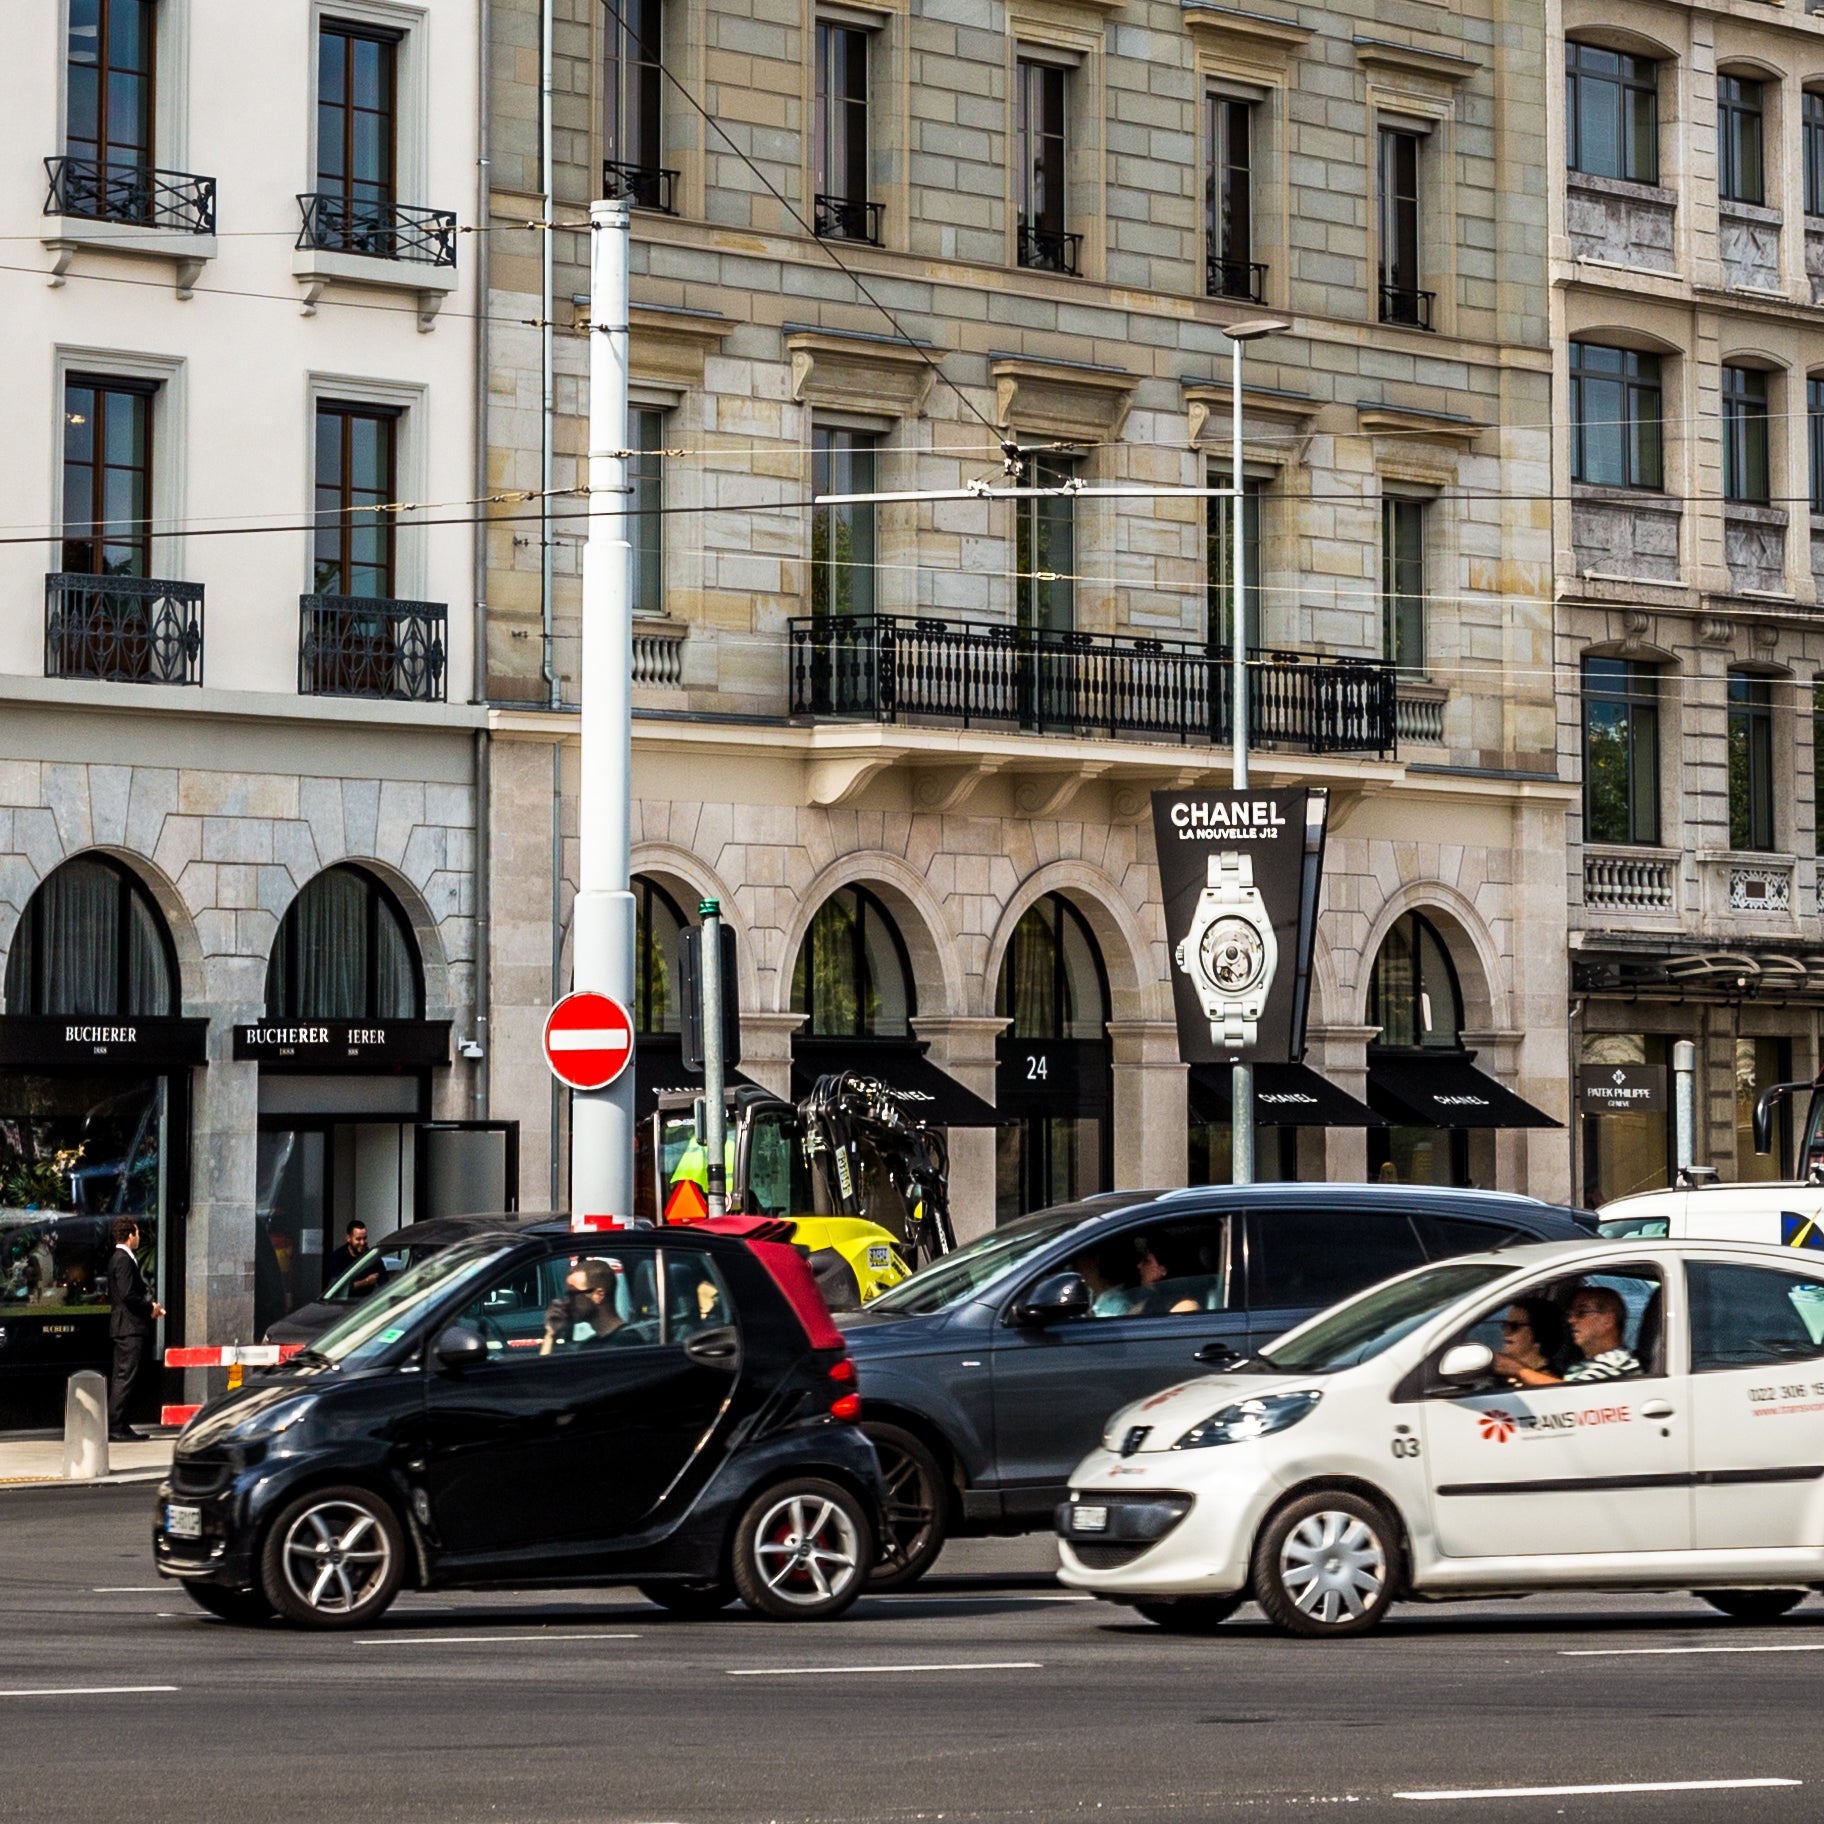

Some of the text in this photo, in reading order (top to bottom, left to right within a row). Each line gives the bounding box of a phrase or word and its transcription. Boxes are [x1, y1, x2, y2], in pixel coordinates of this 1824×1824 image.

[1170, 801, 1286, 827] CHANEL
[1179, 827, 1278, 840] LA NOUVELLE J12
[65, 1026, 137, 1042] BUCHERER
[246, 1028, 329, 1043] BUCHERER
[1026, 1056, 1048, 1080] 24
[1258, 1093, 1318, 1103] CHANEL
[1433, 1095, 1490, 1105] CHANEL
[1587, 1087, 1651, 1098] PATEK PHILIPPE
[1747, 1387, 1776, 1401] 022
[1517, 1405, 1633, 1432] TRANSVOIRIE
[1391, 1438, 1421, 1459] 03
